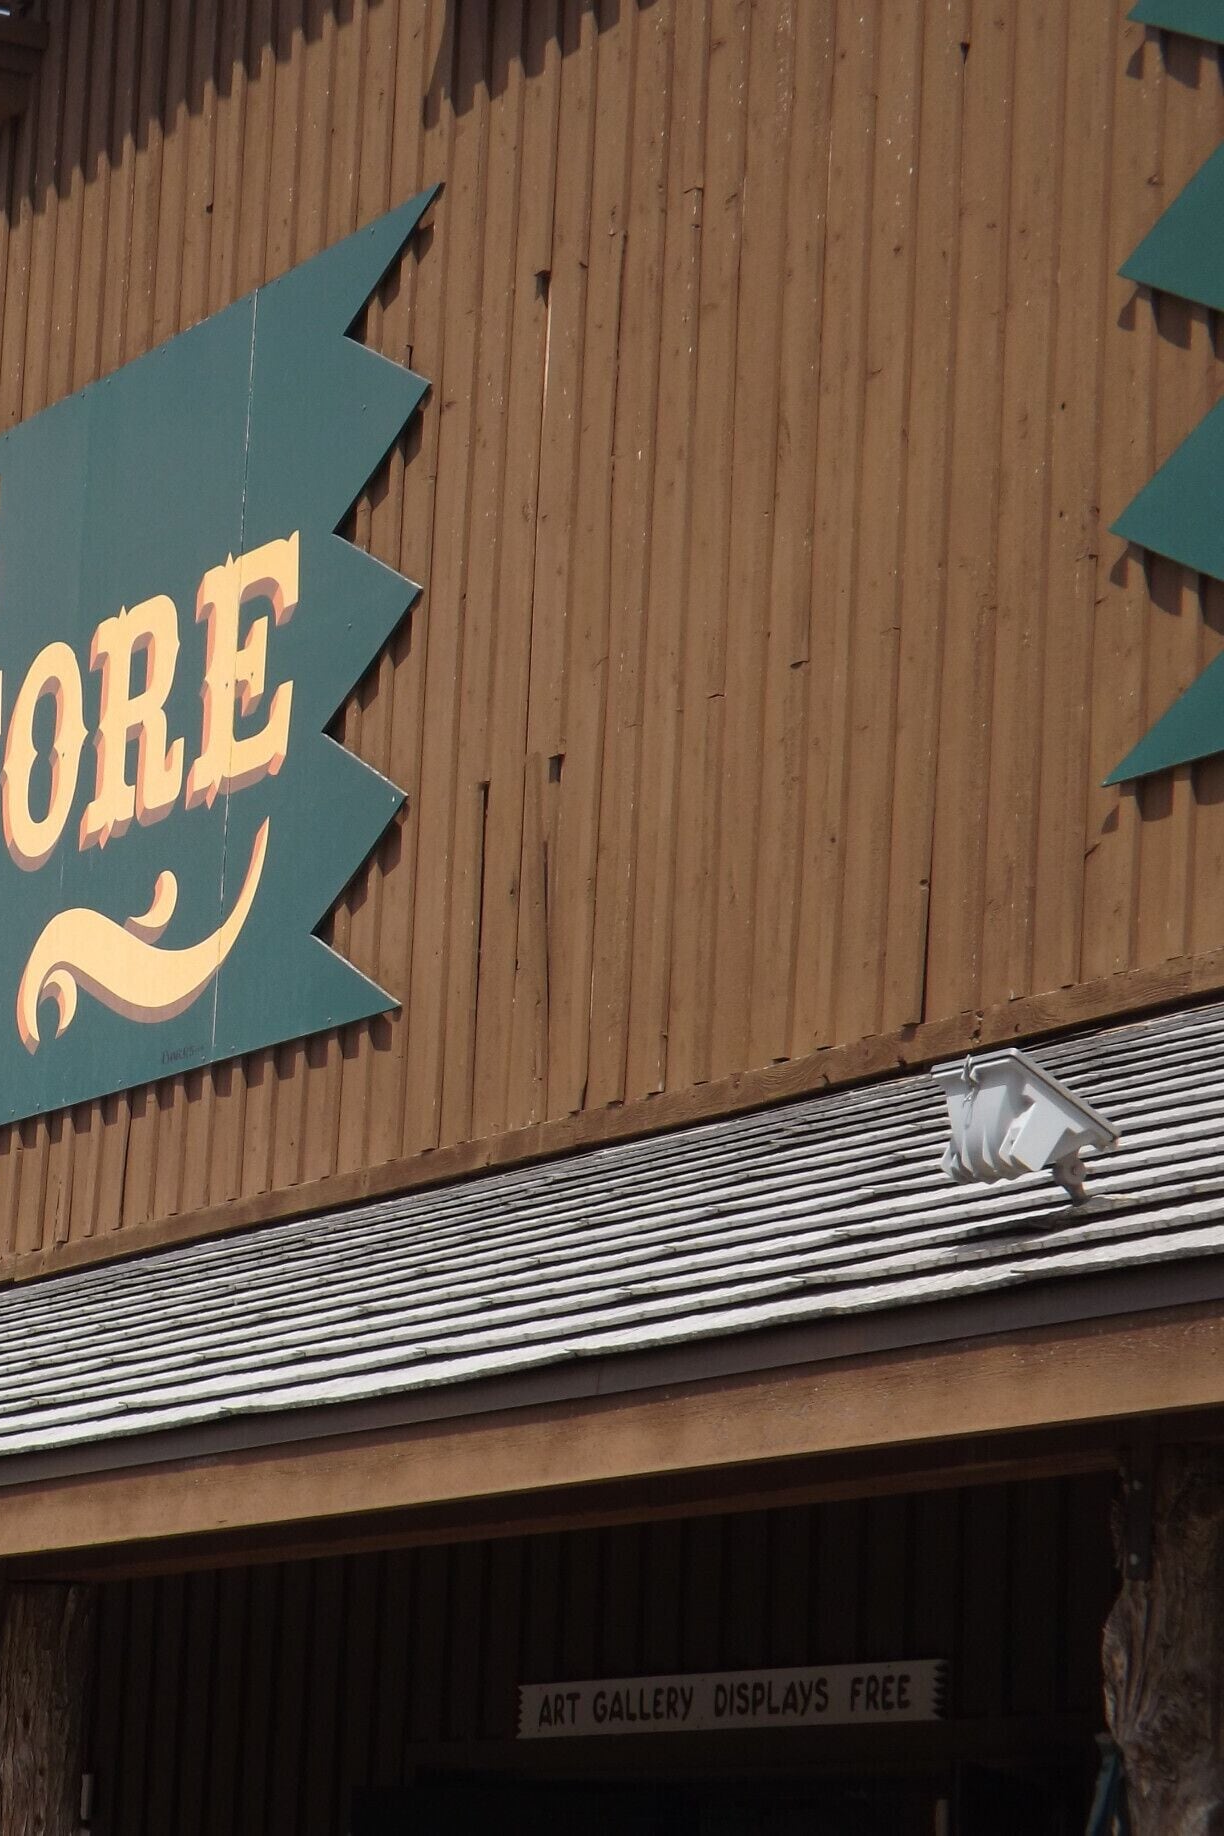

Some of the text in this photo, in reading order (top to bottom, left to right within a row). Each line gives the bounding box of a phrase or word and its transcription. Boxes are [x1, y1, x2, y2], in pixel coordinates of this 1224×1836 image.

[538, 1674, 911, 1728] ART GALLERY DISPLAYS FREE
